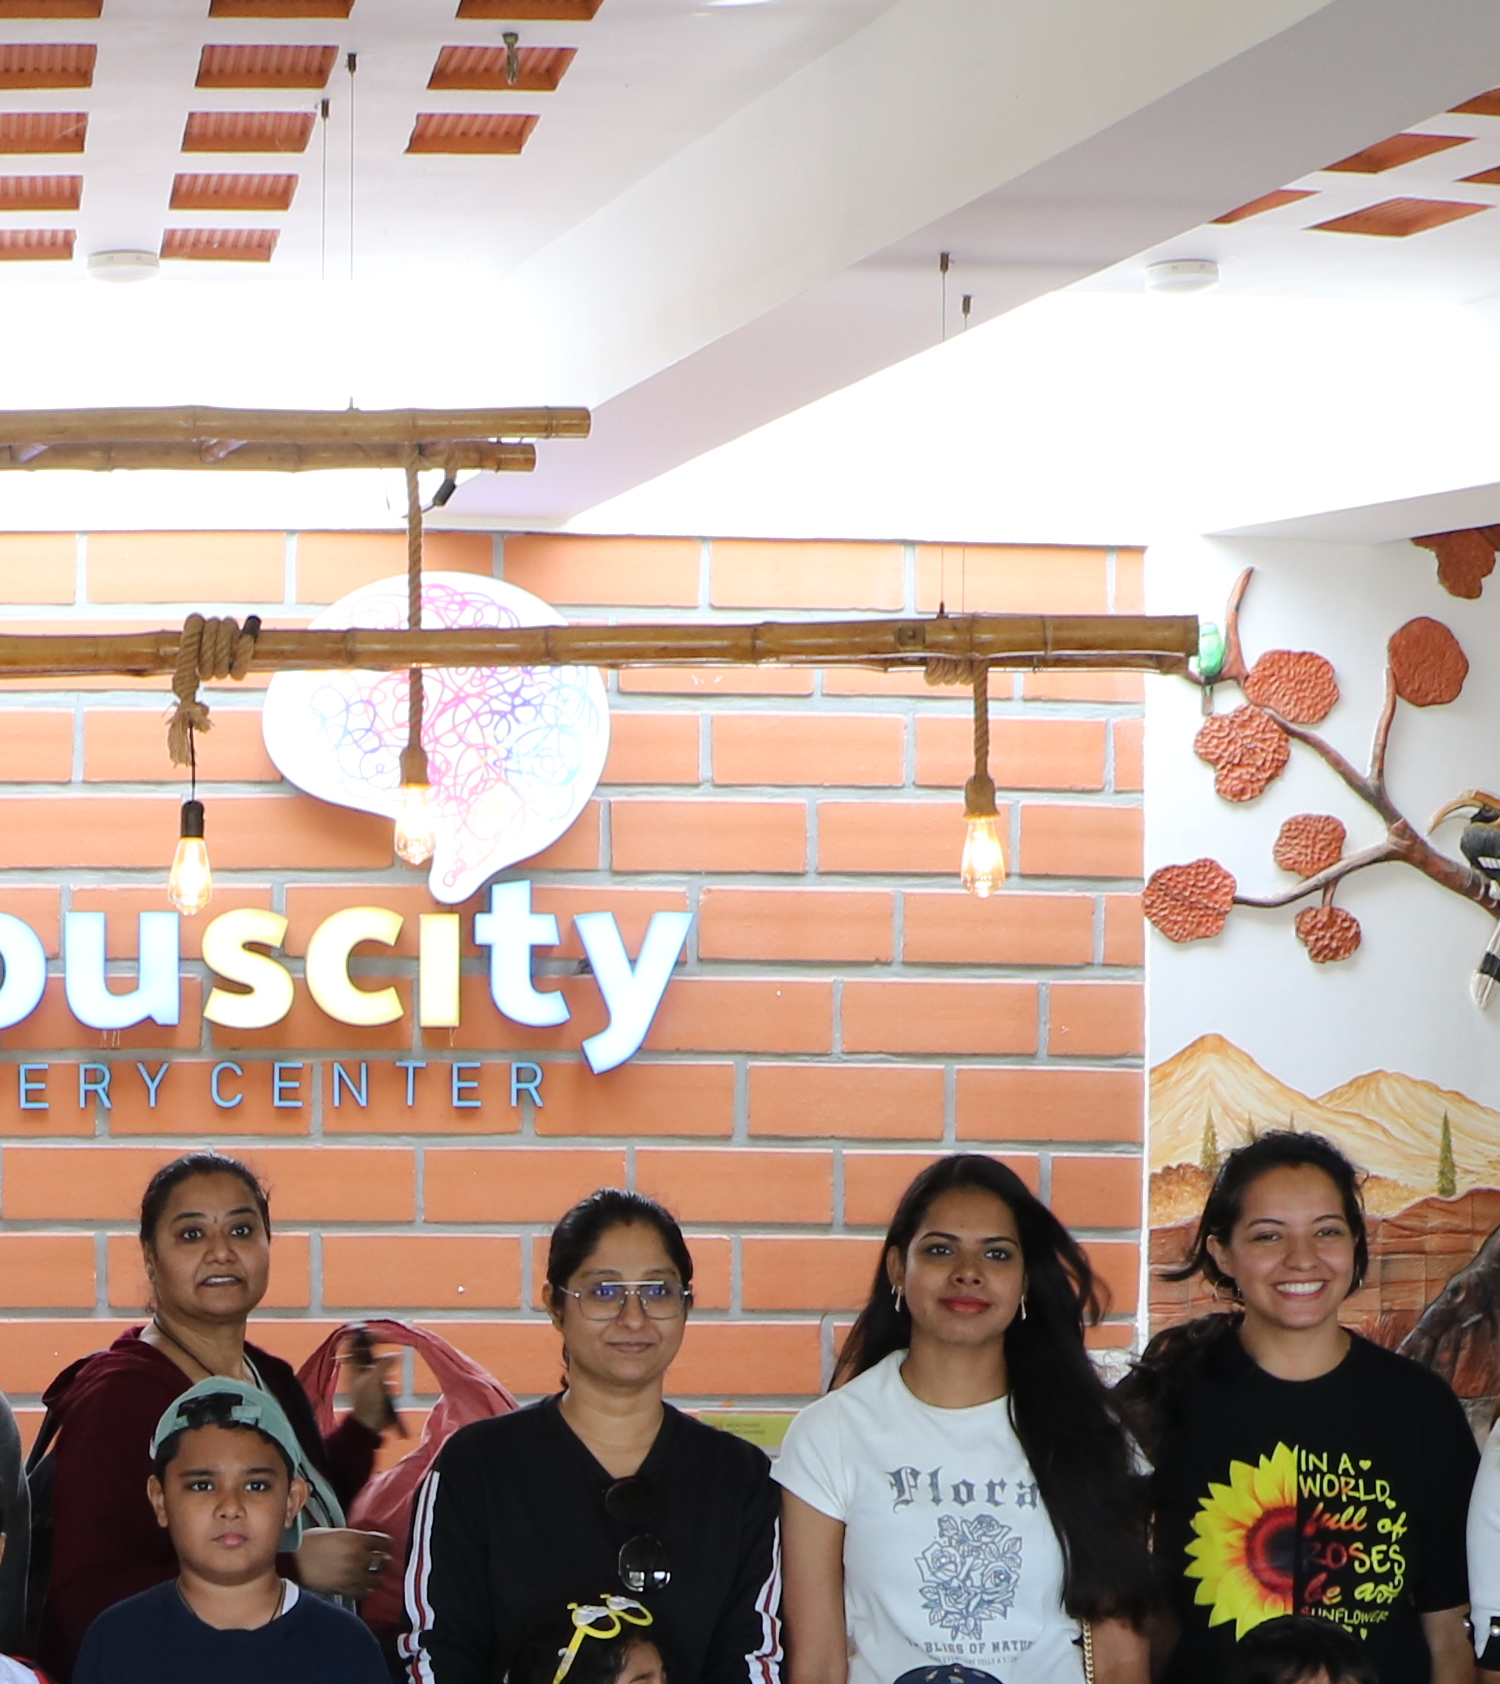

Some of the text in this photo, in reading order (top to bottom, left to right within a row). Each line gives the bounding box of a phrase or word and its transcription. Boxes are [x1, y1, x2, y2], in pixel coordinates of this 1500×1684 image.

[210, 1059, 546, 1109] CENTER
[1300, 1449, 1355, 1475] IN A
[885, 1465, 1039, 1514] Flora
[1299, 1473, 1390, 1502] WORLD
[1302, 1501, 1408, 1542] full of
[969, 1642, 986, 1655] OF
[992, 1639, 1037, 1653] NATU
